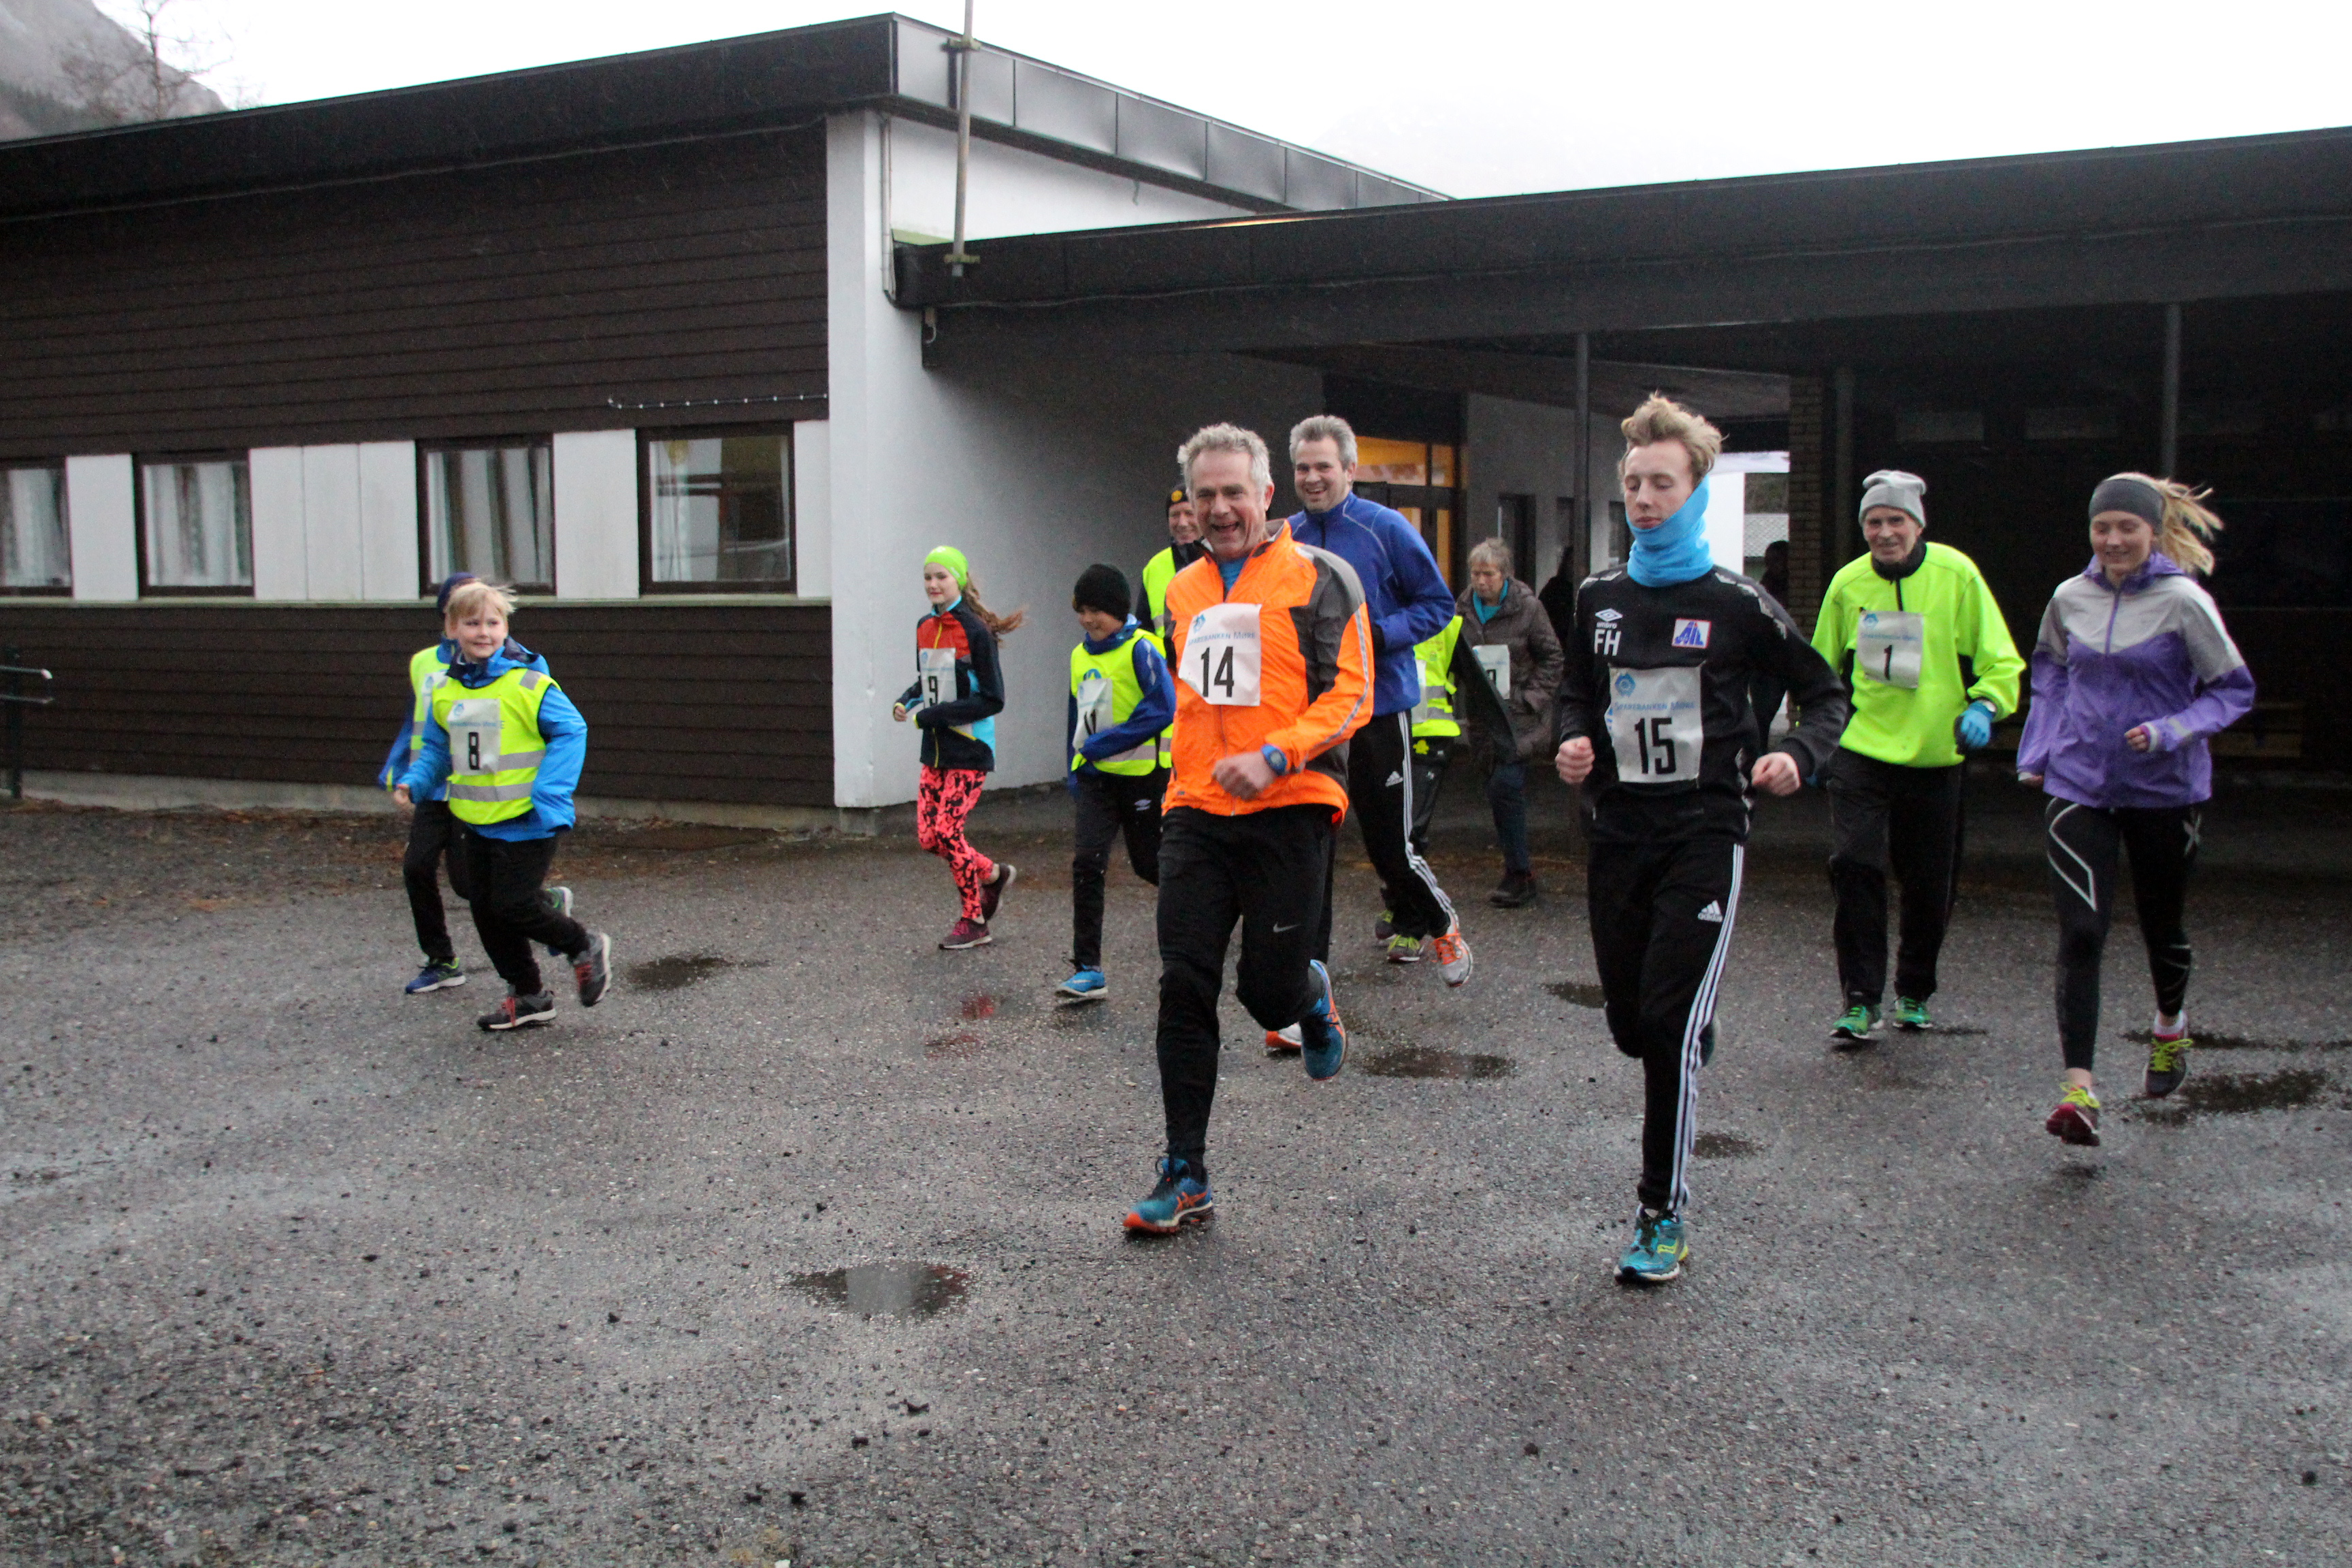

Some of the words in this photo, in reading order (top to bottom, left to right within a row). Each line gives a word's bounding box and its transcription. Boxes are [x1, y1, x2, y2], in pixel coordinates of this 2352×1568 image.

[1594, 628, 1622, 657] FH
[1596, 621, 1618, 629] umbro
[1200, 646, 1235, 698] 14
[1884, 644, 1893, 681] 1
[928, 676, 938, 707] 9
[468, 732, 480, 770] 8
[1635, 717, 1677, 774] 15
